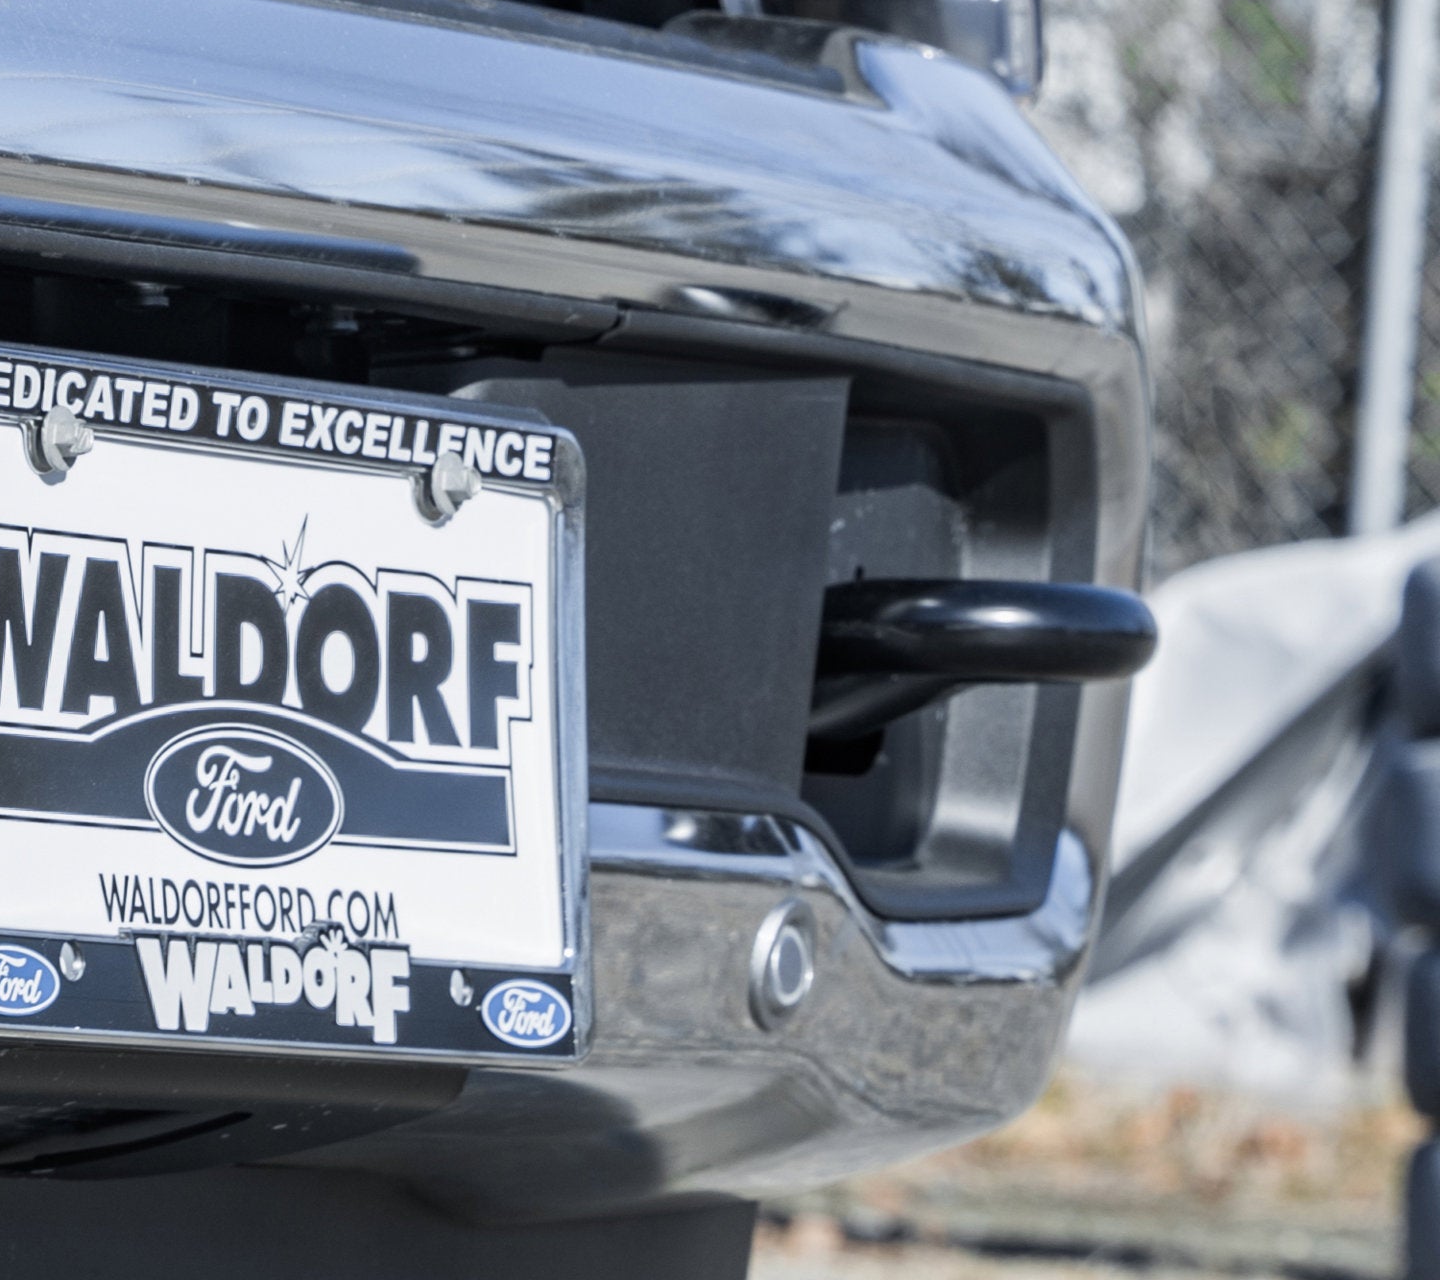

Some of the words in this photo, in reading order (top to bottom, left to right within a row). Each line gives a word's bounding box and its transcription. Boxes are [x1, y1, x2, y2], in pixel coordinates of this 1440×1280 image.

[212, 391, 270, 442] TO
[280, 401, 553, 481] EXCELLENCE
[185, 745, 301, 843] Ford
[99, 873, 399, 939] WALDORFFORDCOM
[136, 937, 411, 1044] WALDORF
[498, 988, 556, 1037] Ford
